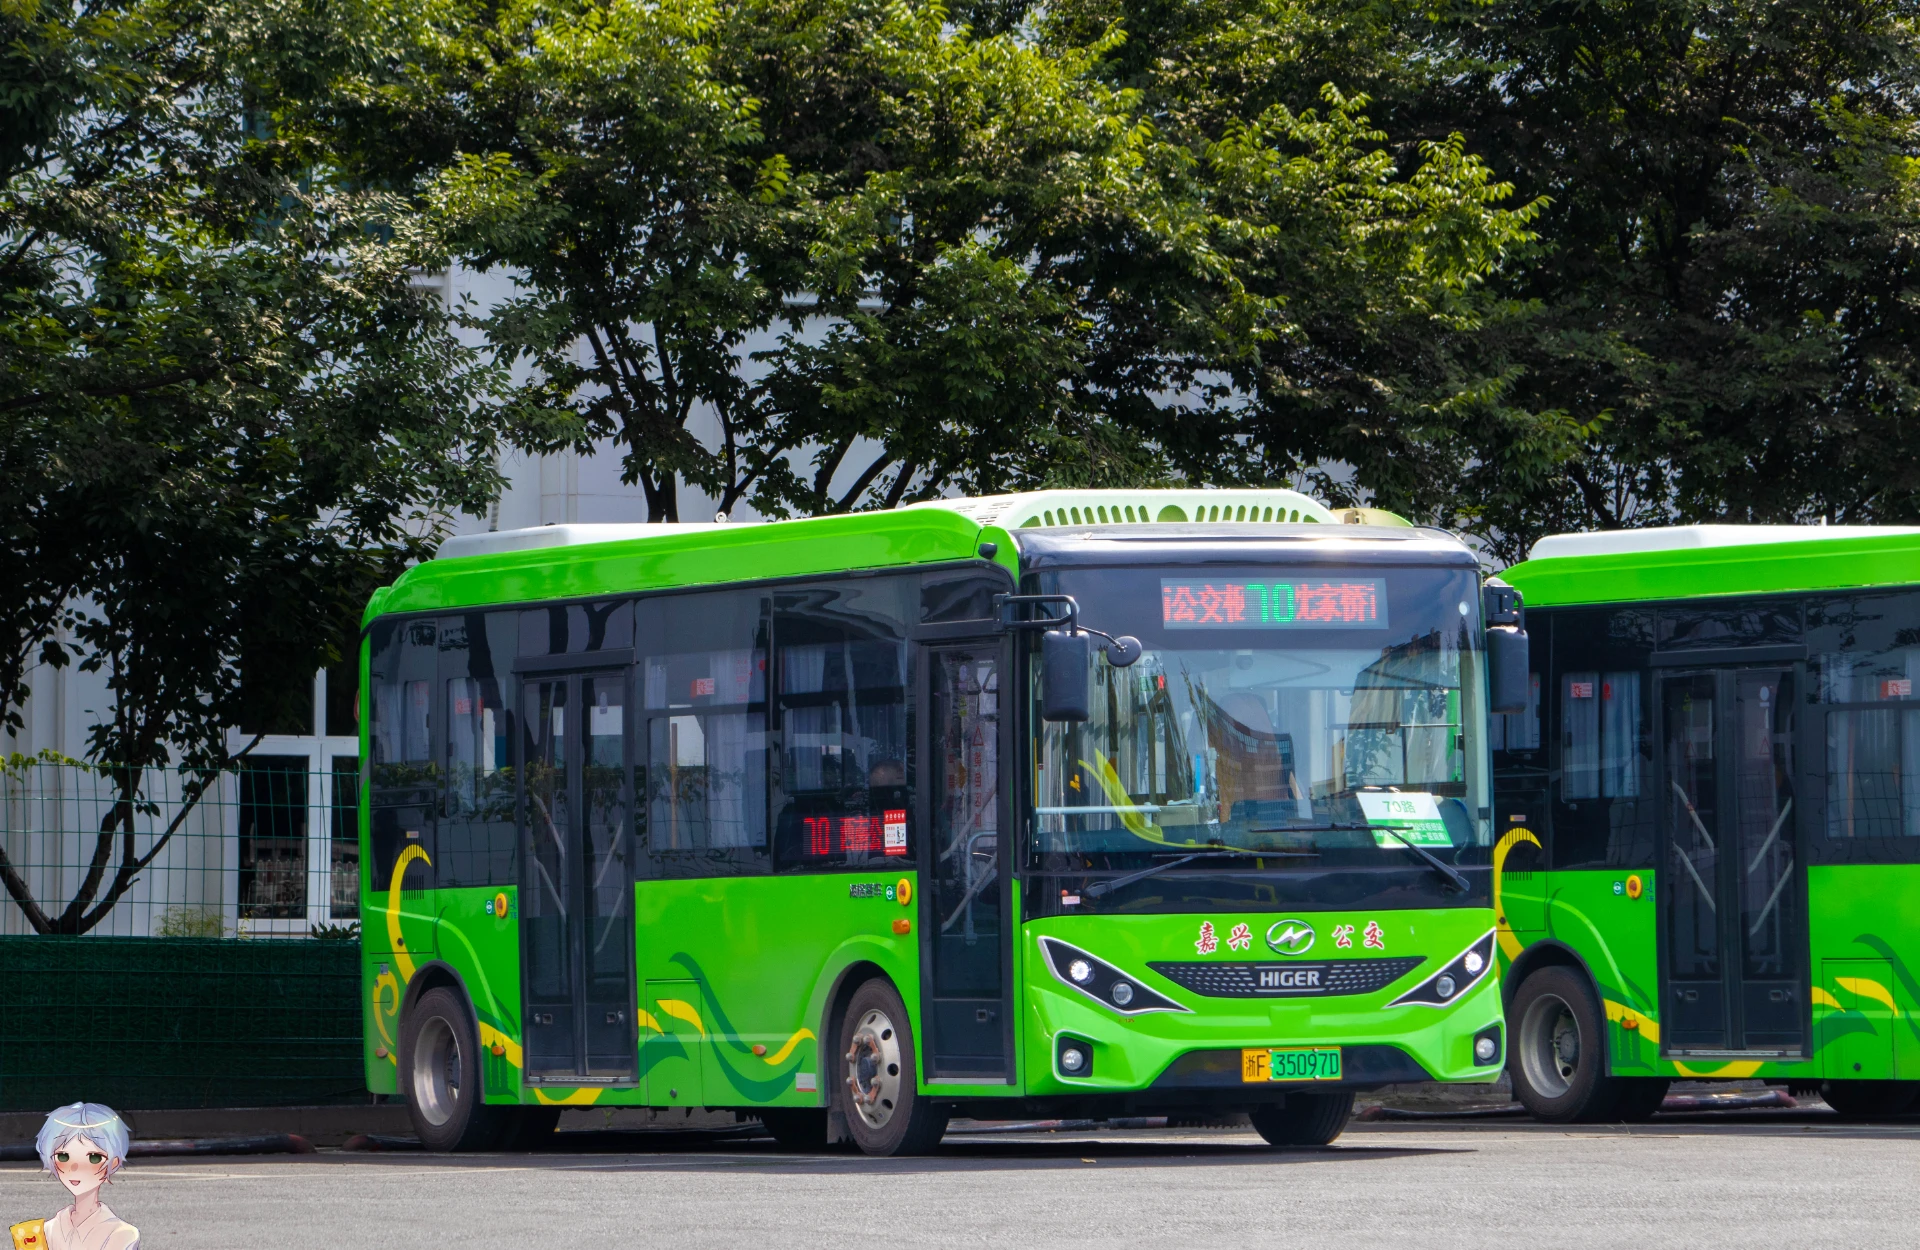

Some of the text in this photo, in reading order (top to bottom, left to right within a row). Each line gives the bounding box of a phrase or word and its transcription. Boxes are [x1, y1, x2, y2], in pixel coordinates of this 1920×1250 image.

[1246, 583, 1295, 623] 70
[1382, 800, 1416, 814] 70路
[803, 817, 831, 855] 70
[839, 815, 884, 852] 西南公
[1195, 921, 1385, 955] 嘉兴 公交
[1260, 971, 1320, 987] HIGER
[1245, 1053, 1339, 1077] 浙F 35097D
